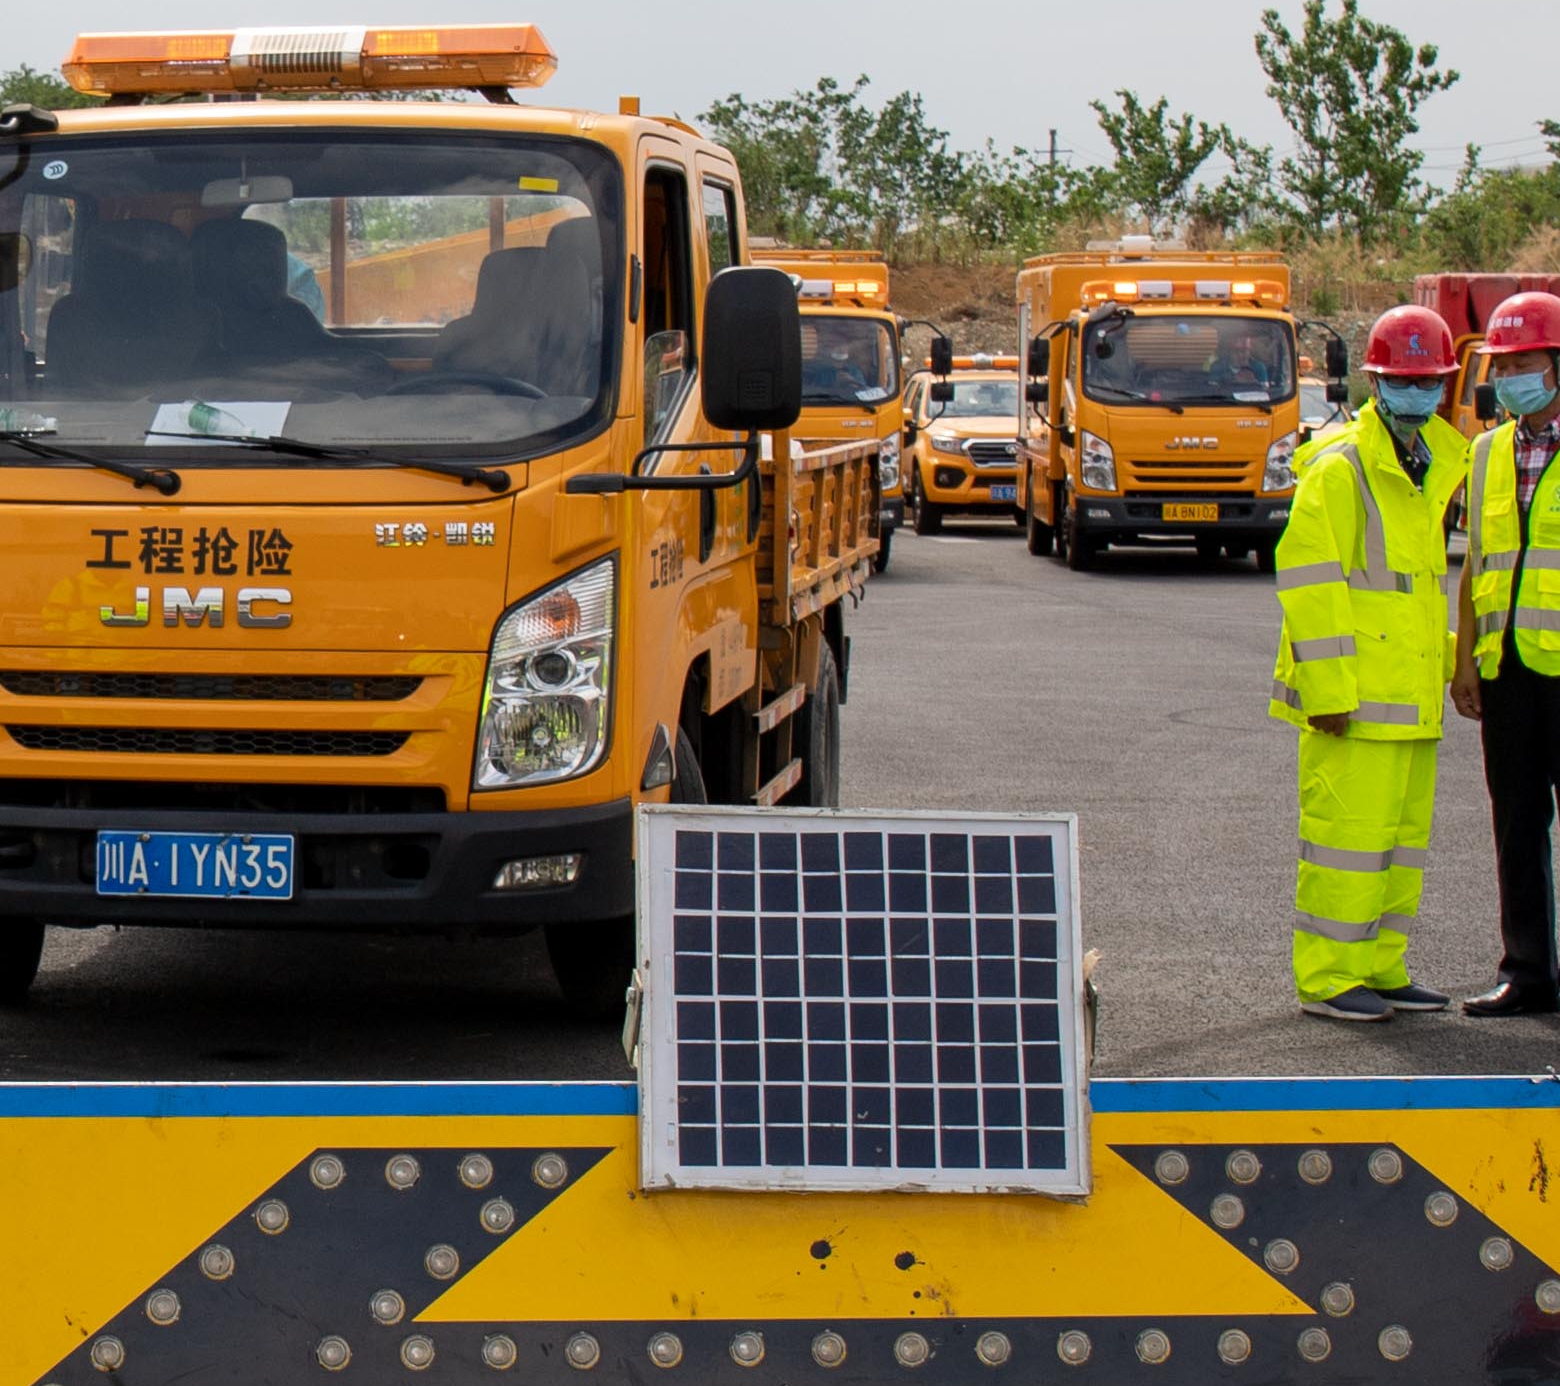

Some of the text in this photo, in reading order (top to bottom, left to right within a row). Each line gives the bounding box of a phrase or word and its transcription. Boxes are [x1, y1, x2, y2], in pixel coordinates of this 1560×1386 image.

[1165, 437, 1219, 449] JMC
[86, 526, 294, 576] 工程抢险
[99, 586, 293, 629] JMC
